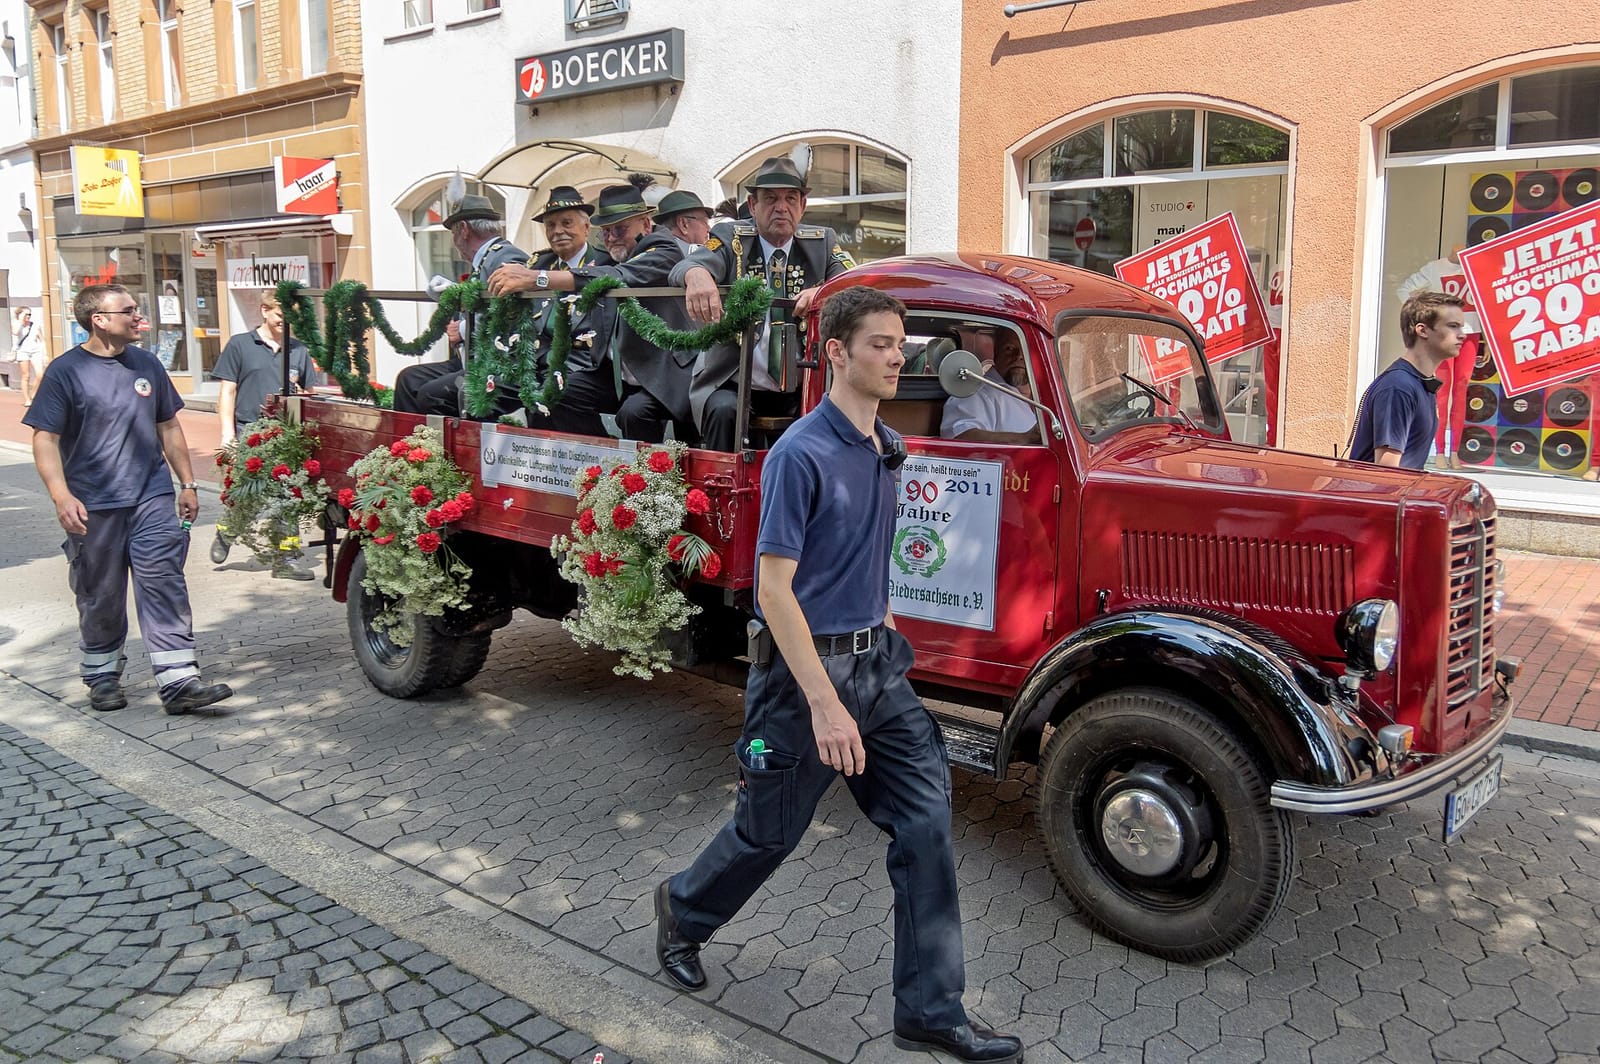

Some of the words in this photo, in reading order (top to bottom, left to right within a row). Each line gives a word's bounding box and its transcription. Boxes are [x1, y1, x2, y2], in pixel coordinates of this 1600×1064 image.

[551, 40, 668, 89] BOECKER
[294, 171, 324, 193] haar
[1150, 202, 1185, 212] STUDIO
[1157, 224, 1185, 235] mavi
[1146, 236, 1211, 283] JETZT
[1502, 219, 1597, 276] JETZT
[1150, 258, 1232, 299] OCHMALS
[914, 463, 929, 474] sein,
[930, 464, 947, 475] heißt
[948, 466, 962, 476] treu
[905, 479, 938, 504] 90
[944, 479, 993, 497] 2011
